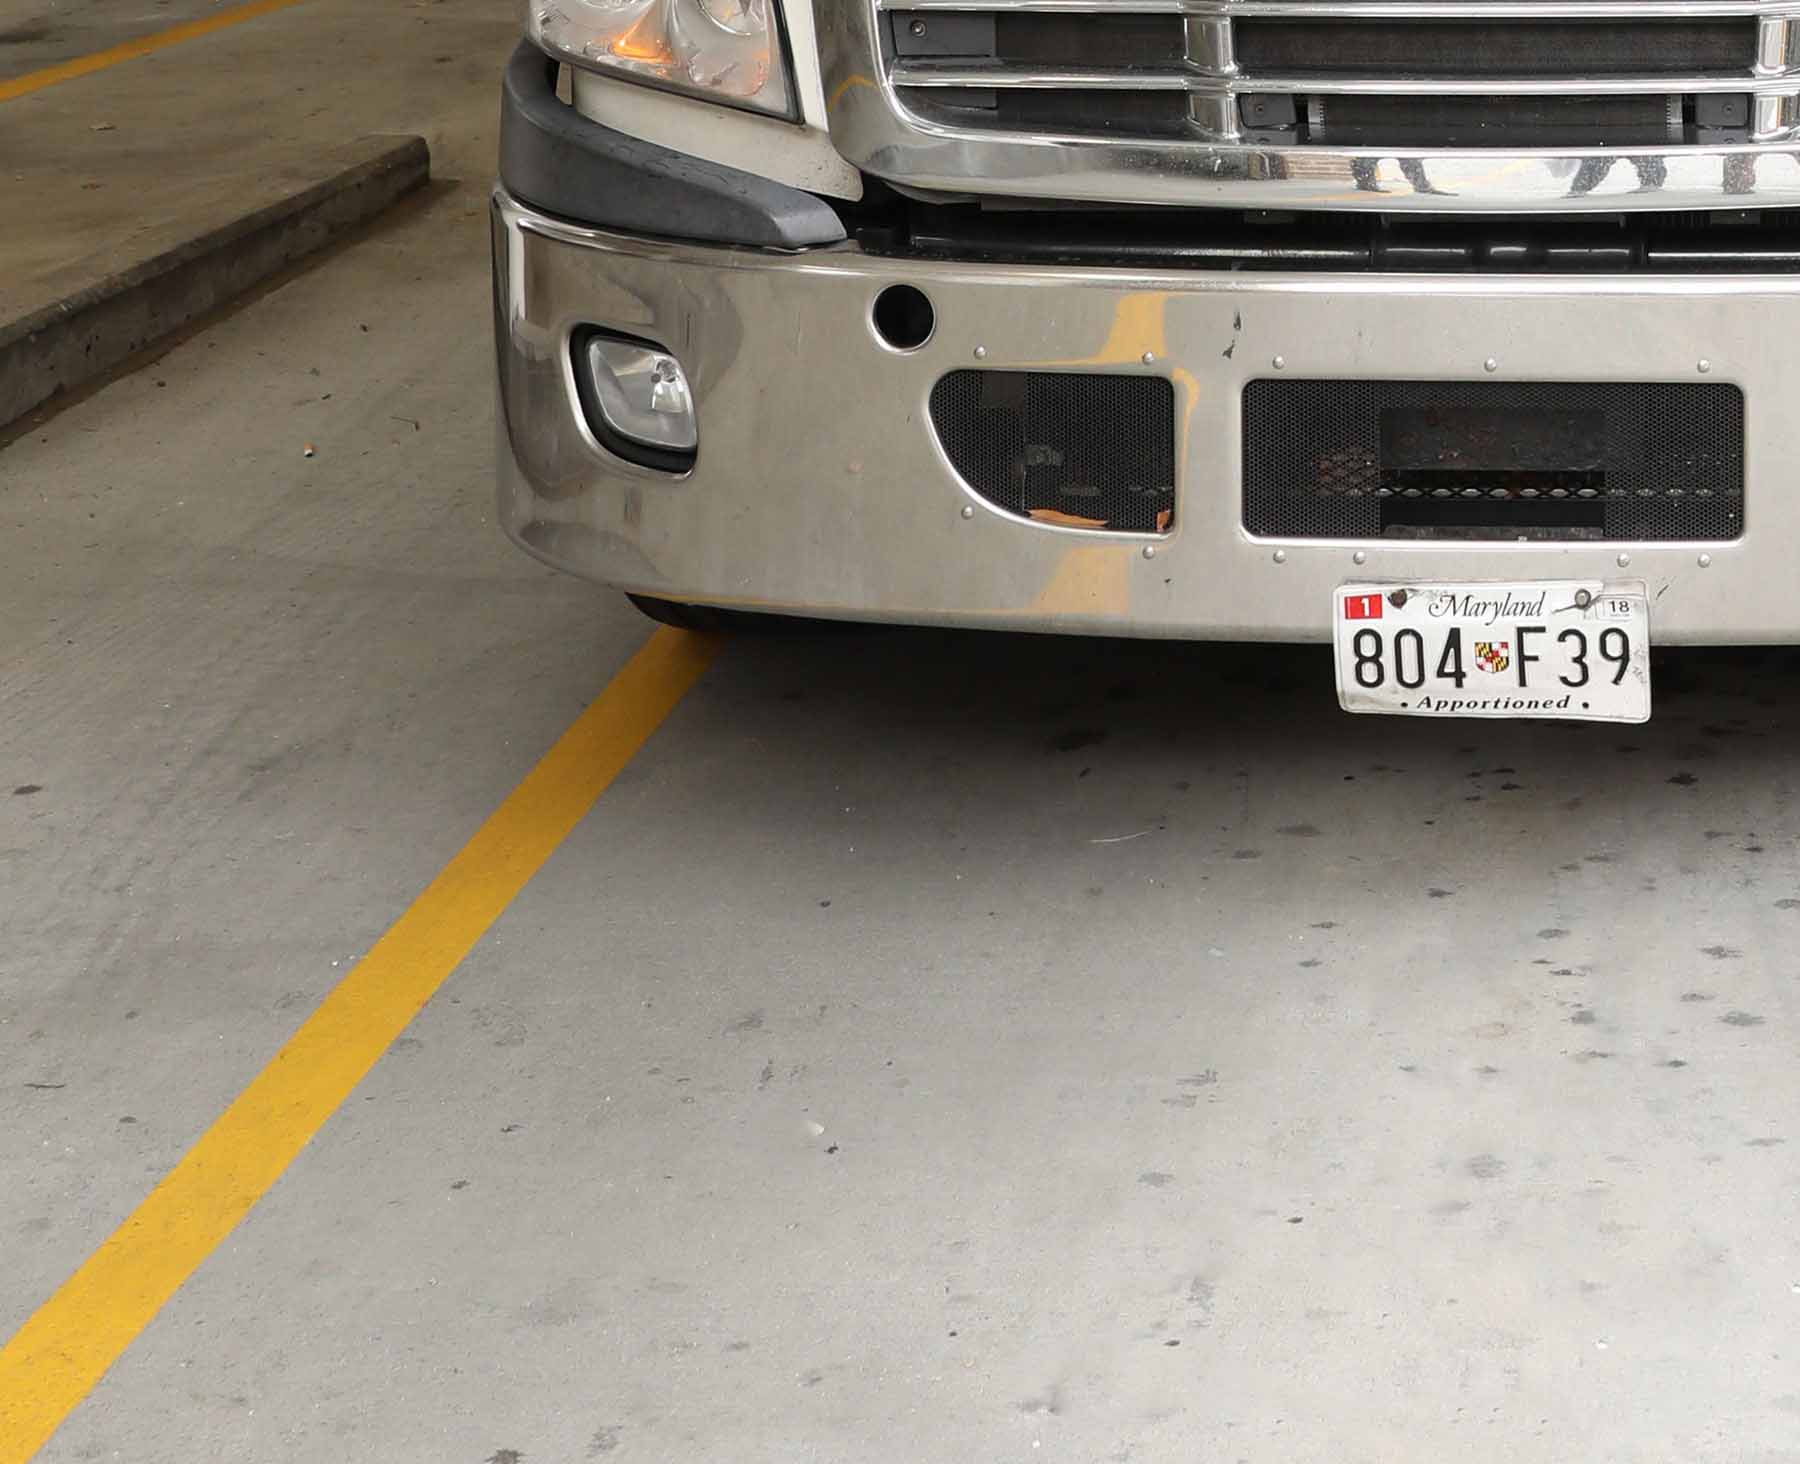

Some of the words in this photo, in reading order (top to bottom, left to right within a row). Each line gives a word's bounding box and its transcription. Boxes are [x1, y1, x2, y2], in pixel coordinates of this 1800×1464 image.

[1428, 591, 1544, 626] Maryland
[1608, 600, 1630, 614] 18
[1352, 626, 1467, 689] 804
[1515, 625, 1631, 687] F39
[1416, 694, 1571, 713] Apportioned
